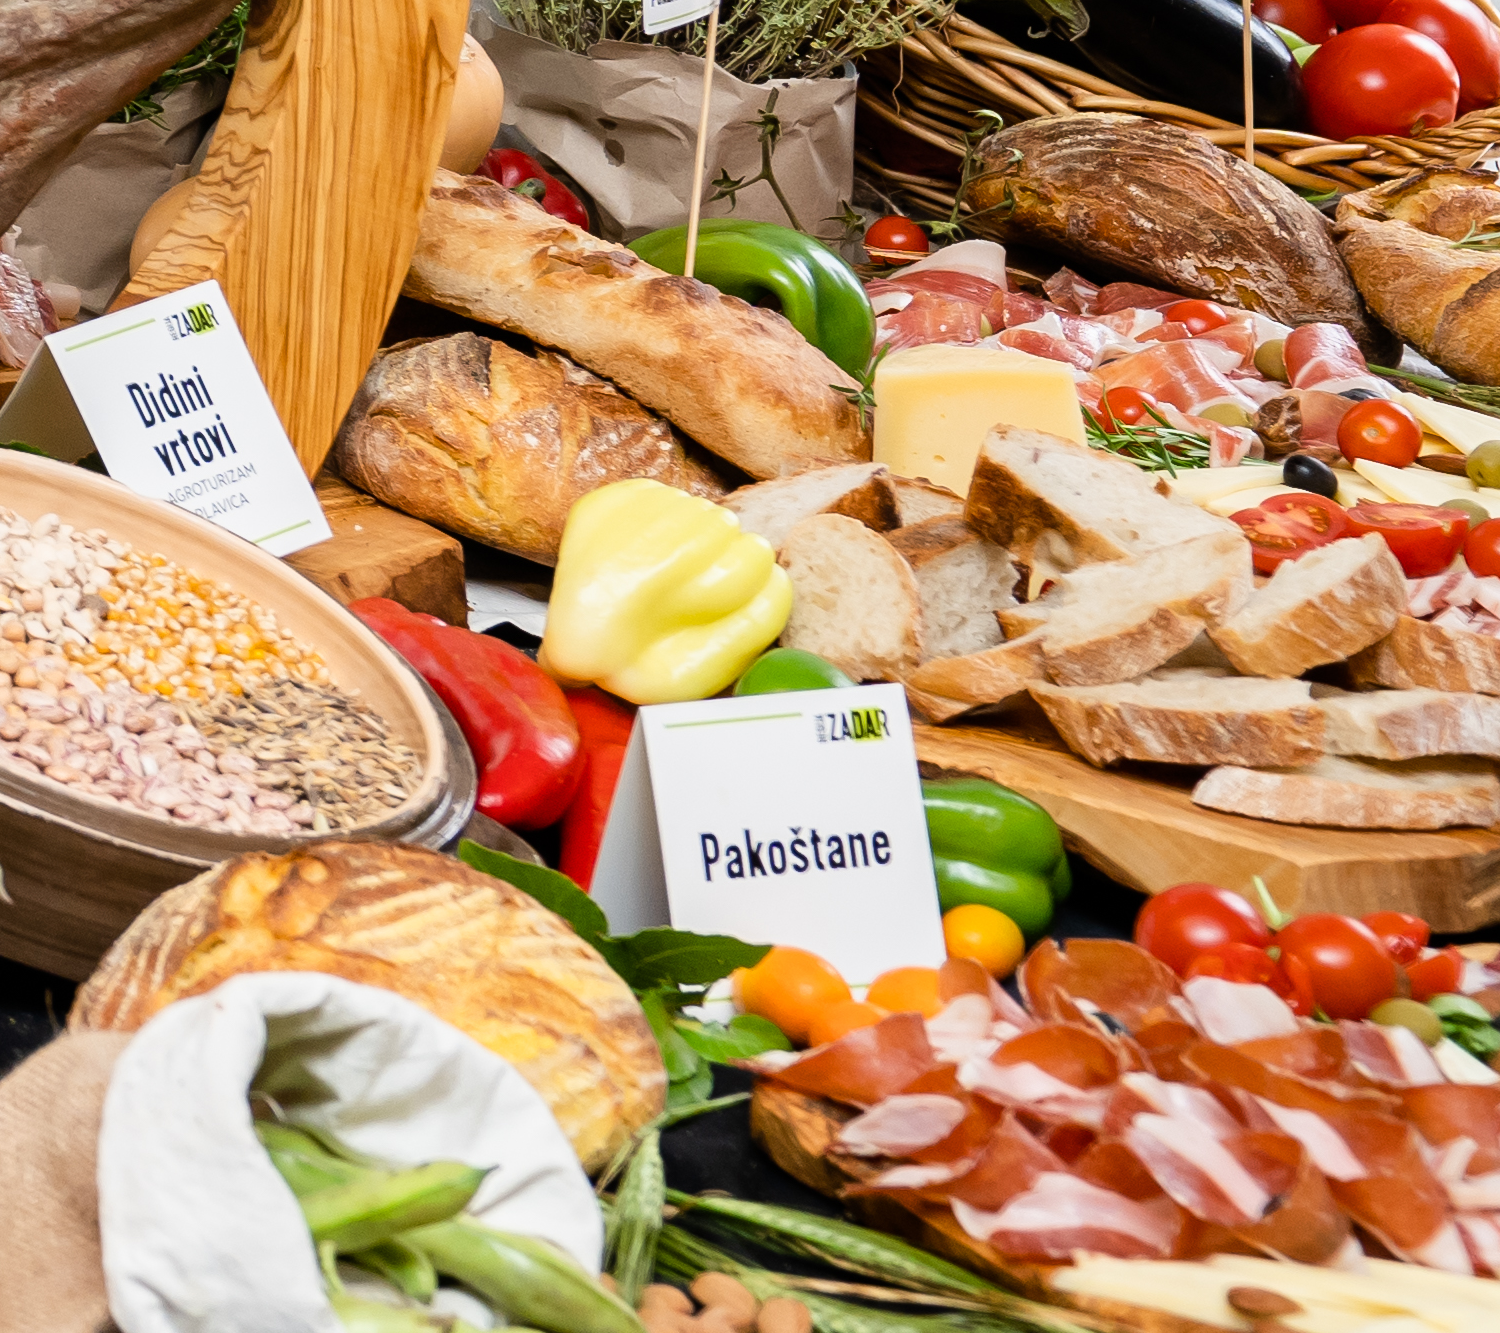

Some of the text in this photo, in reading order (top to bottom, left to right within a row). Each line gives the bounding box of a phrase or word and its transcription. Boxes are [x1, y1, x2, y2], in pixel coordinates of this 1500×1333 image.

[125, 365, 214, 428] Didini
[153, 413, 238, 477] vrtovi
[168, 462, 257, 504] AGROTURIZAM
[699, 826, 892, 882] Pakoštane
